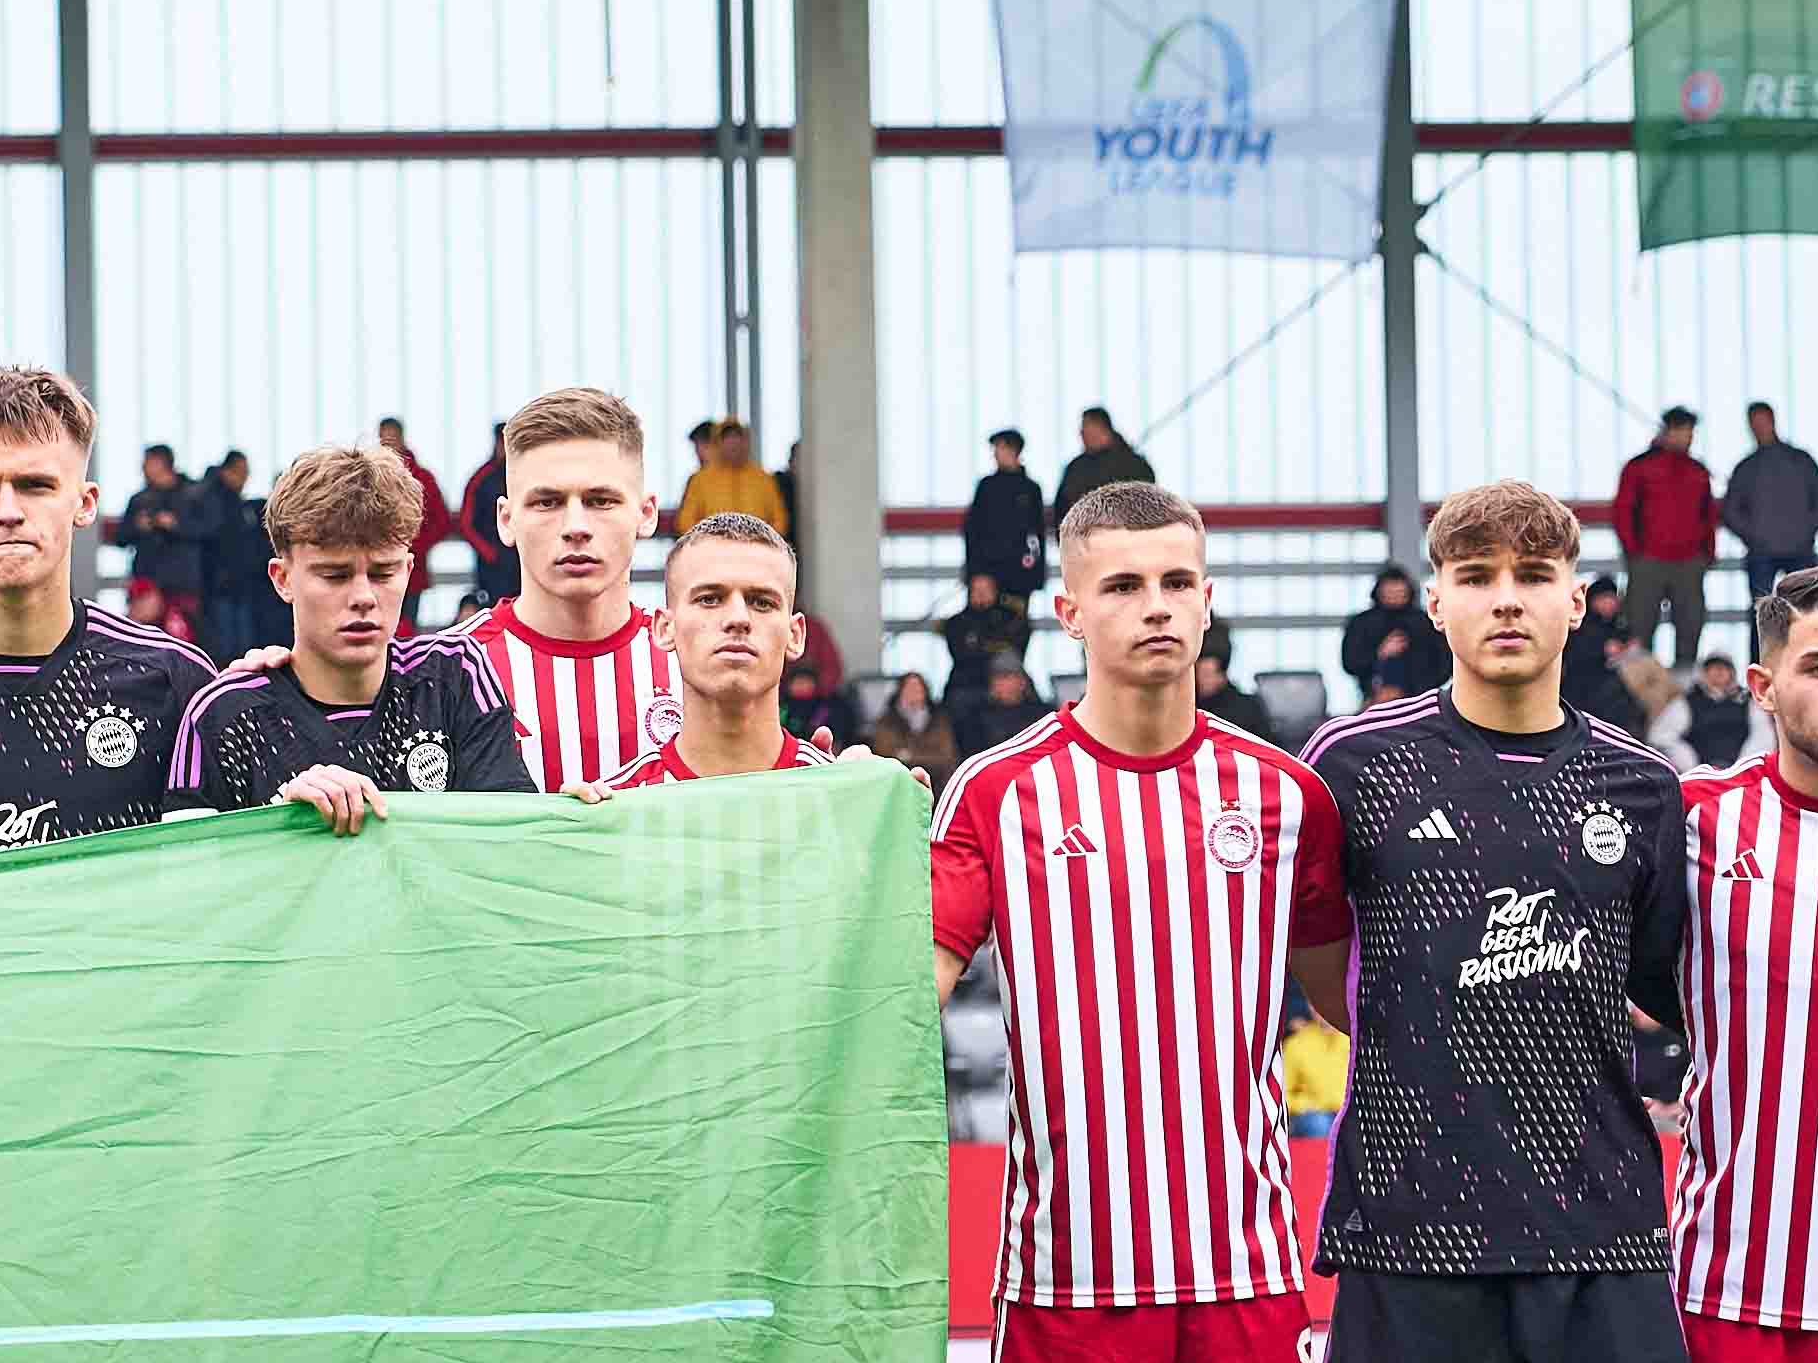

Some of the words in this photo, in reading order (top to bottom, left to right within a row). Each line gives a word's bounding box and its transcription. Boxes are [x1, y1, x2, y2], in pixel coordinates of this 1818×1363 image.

[1094, 124, 1275, 166] YOUTH
[1485, 887, 1556, 929] ROT
[1481, 909, 1550, 956] GEGEN
[1459, 928, 1590, 989] RASSISMUS
